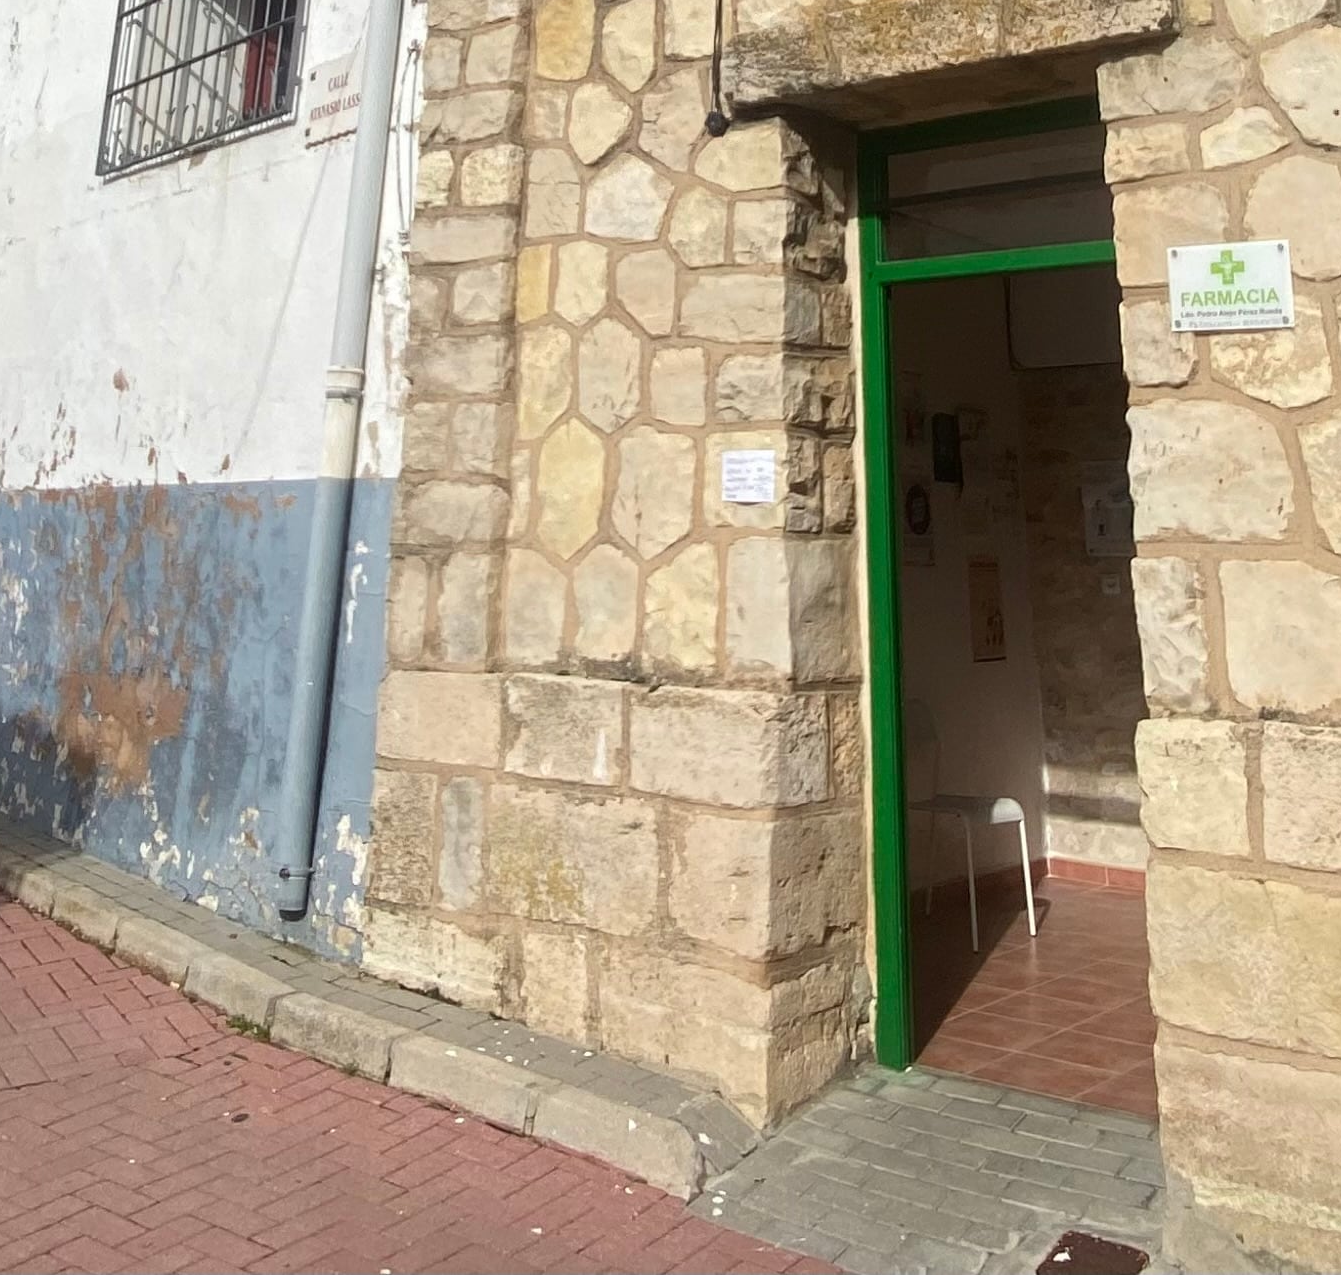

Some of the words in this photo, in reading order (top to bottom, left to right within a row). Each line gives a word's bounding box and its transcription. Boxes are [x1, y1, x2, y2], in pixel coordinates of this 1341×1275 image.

[329, 72, 348, 92] CALLE
[343, 93, 362, 111] LASS
[1180, 287, 1279, 307] FARMACIA
